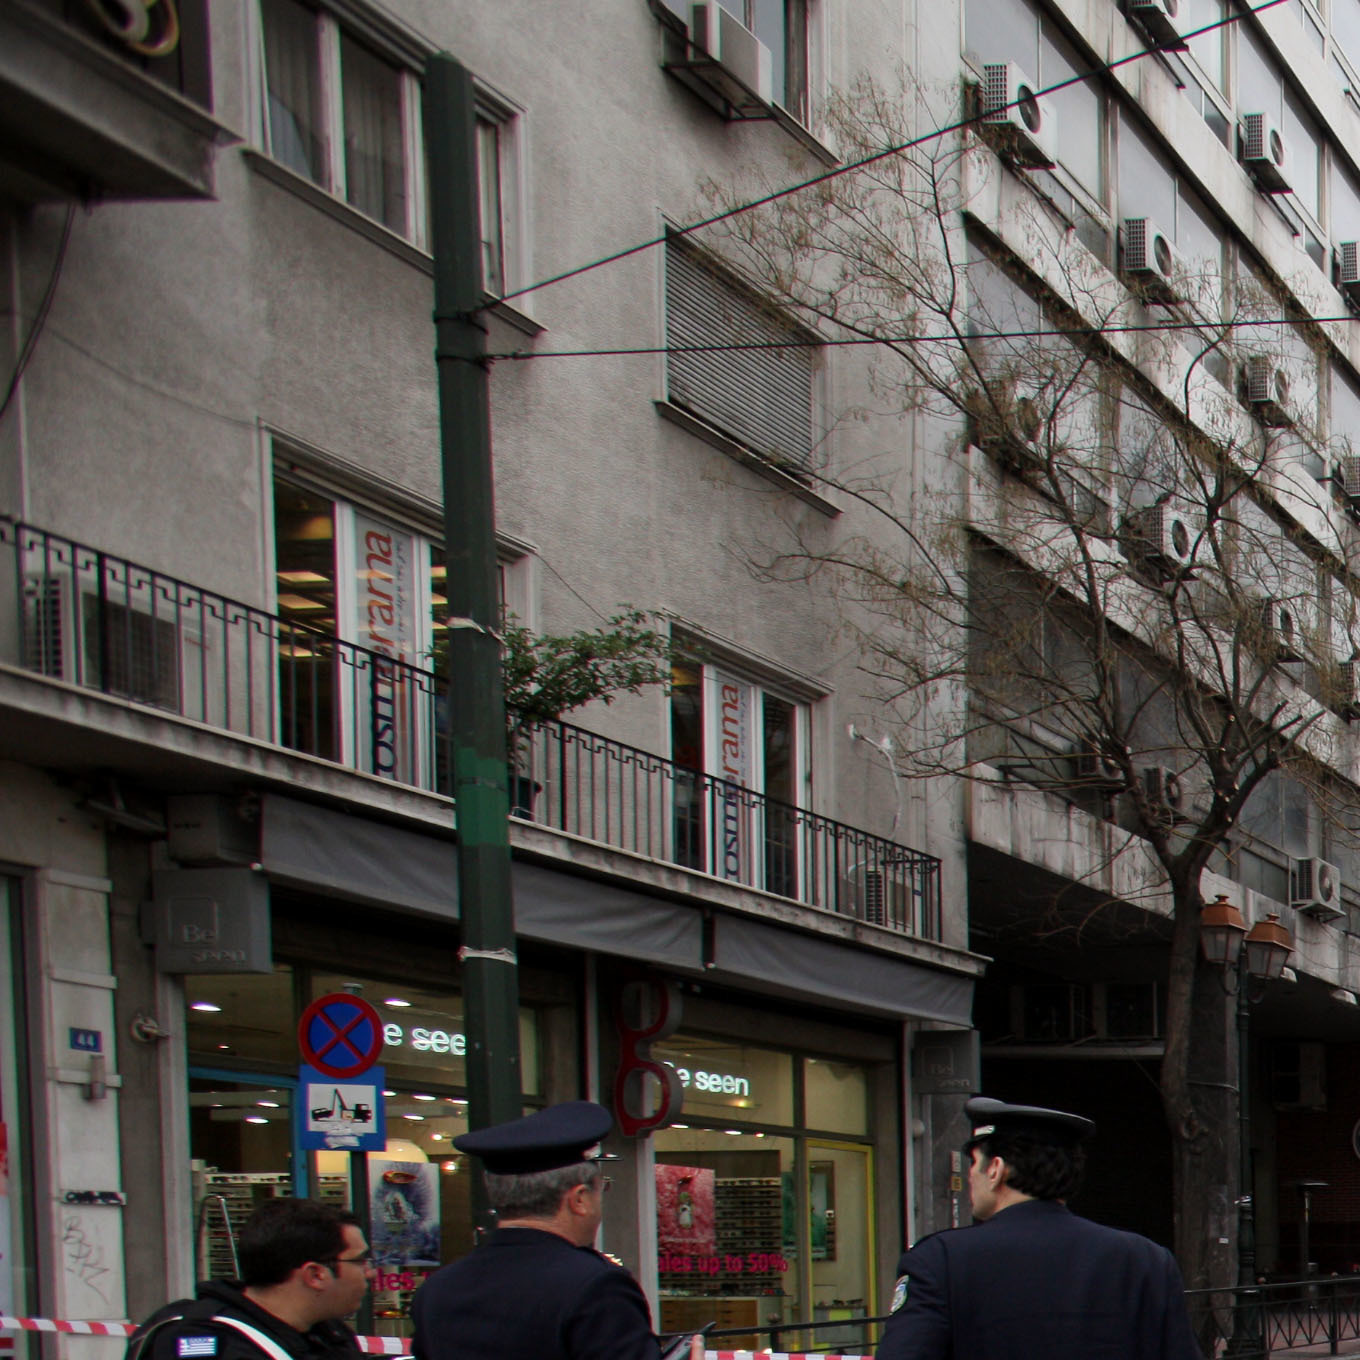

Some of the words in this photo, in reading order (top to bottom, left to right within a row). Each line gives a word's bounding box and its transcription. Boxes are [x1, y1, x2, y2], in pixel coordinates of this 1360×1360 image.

[412, 1028, 466, 1056] see
[695, 1071, 749, 1096] seen
[697, 1255, 721, 1275] up
[725, 1253, 743, 1272] to
[747, 1252, 788, 1273] 50%
